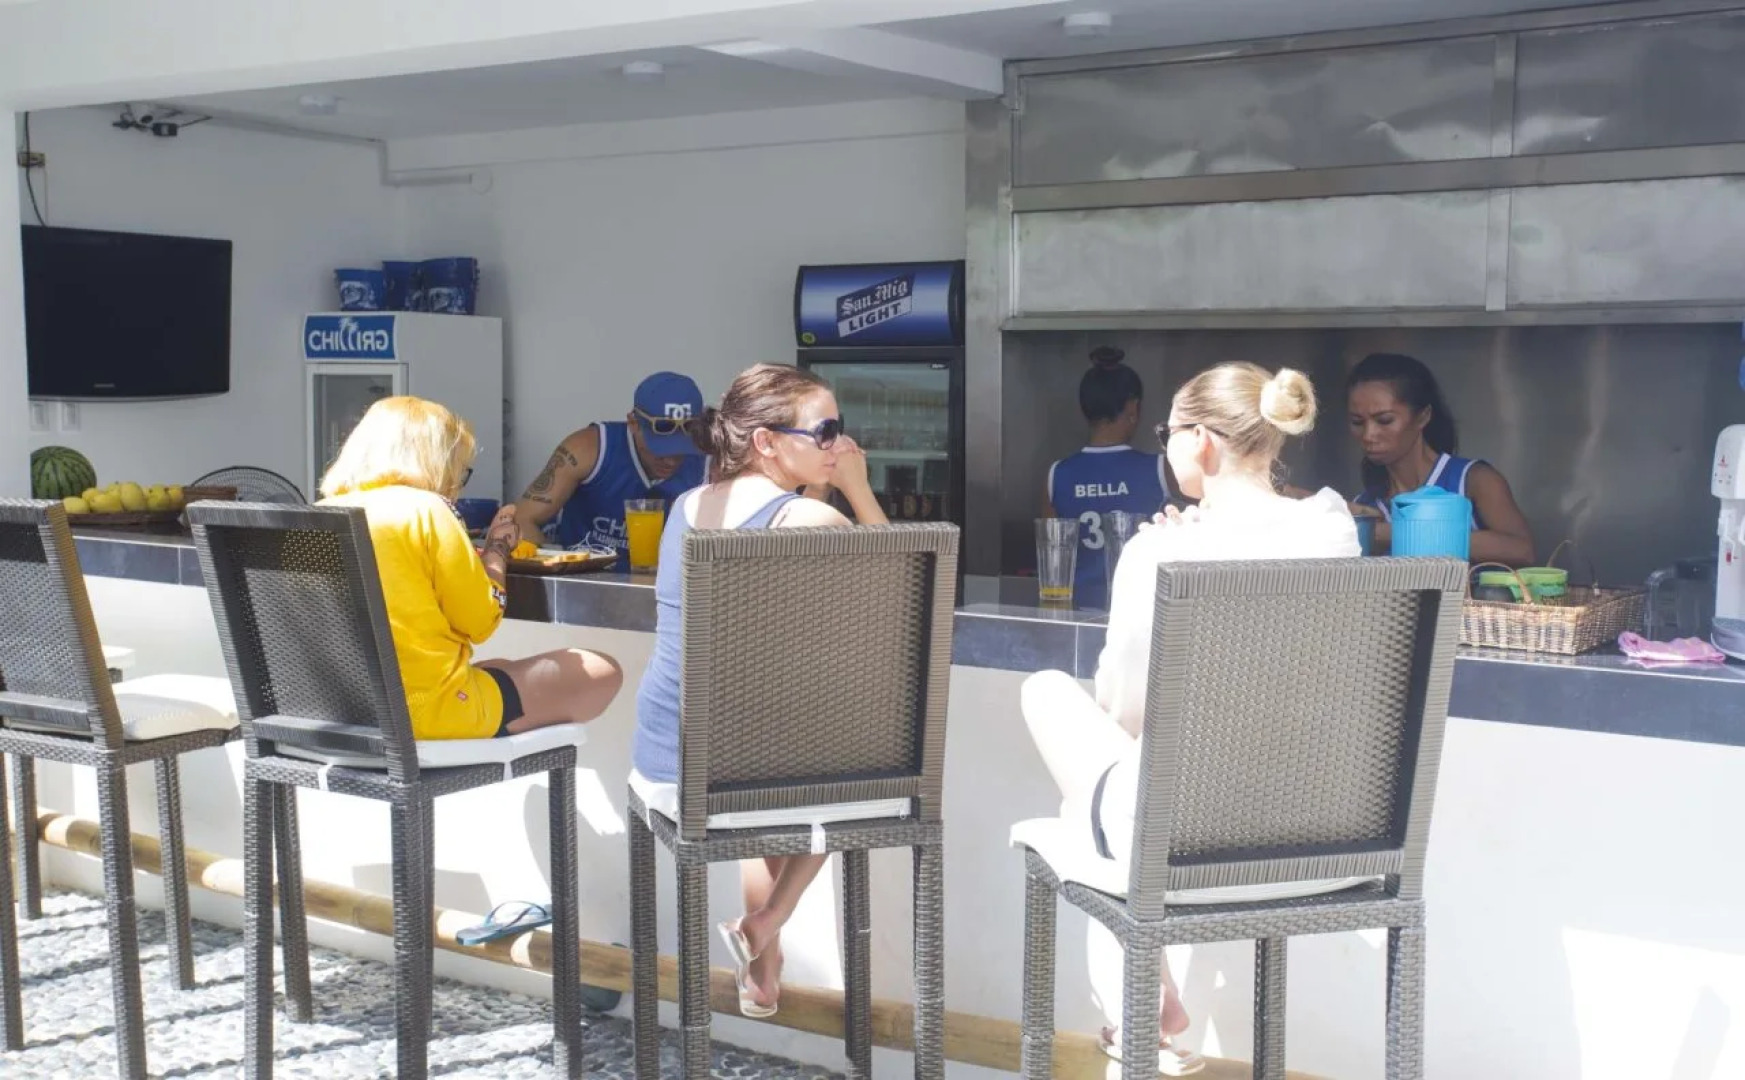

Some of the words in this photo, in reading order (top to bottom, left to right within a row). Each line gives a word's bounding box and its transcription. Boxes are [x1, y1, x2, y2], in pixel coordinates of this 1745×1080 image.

[841, 295, 871, 316] San
[873, 279, 908, 305] Mig
[849, 302, 901, 331] LIGHT
[1075, 481, 1129, 498] BELLA
[593, 516, 627, 538] CH
[1079, 509, 1122, 549] 3
